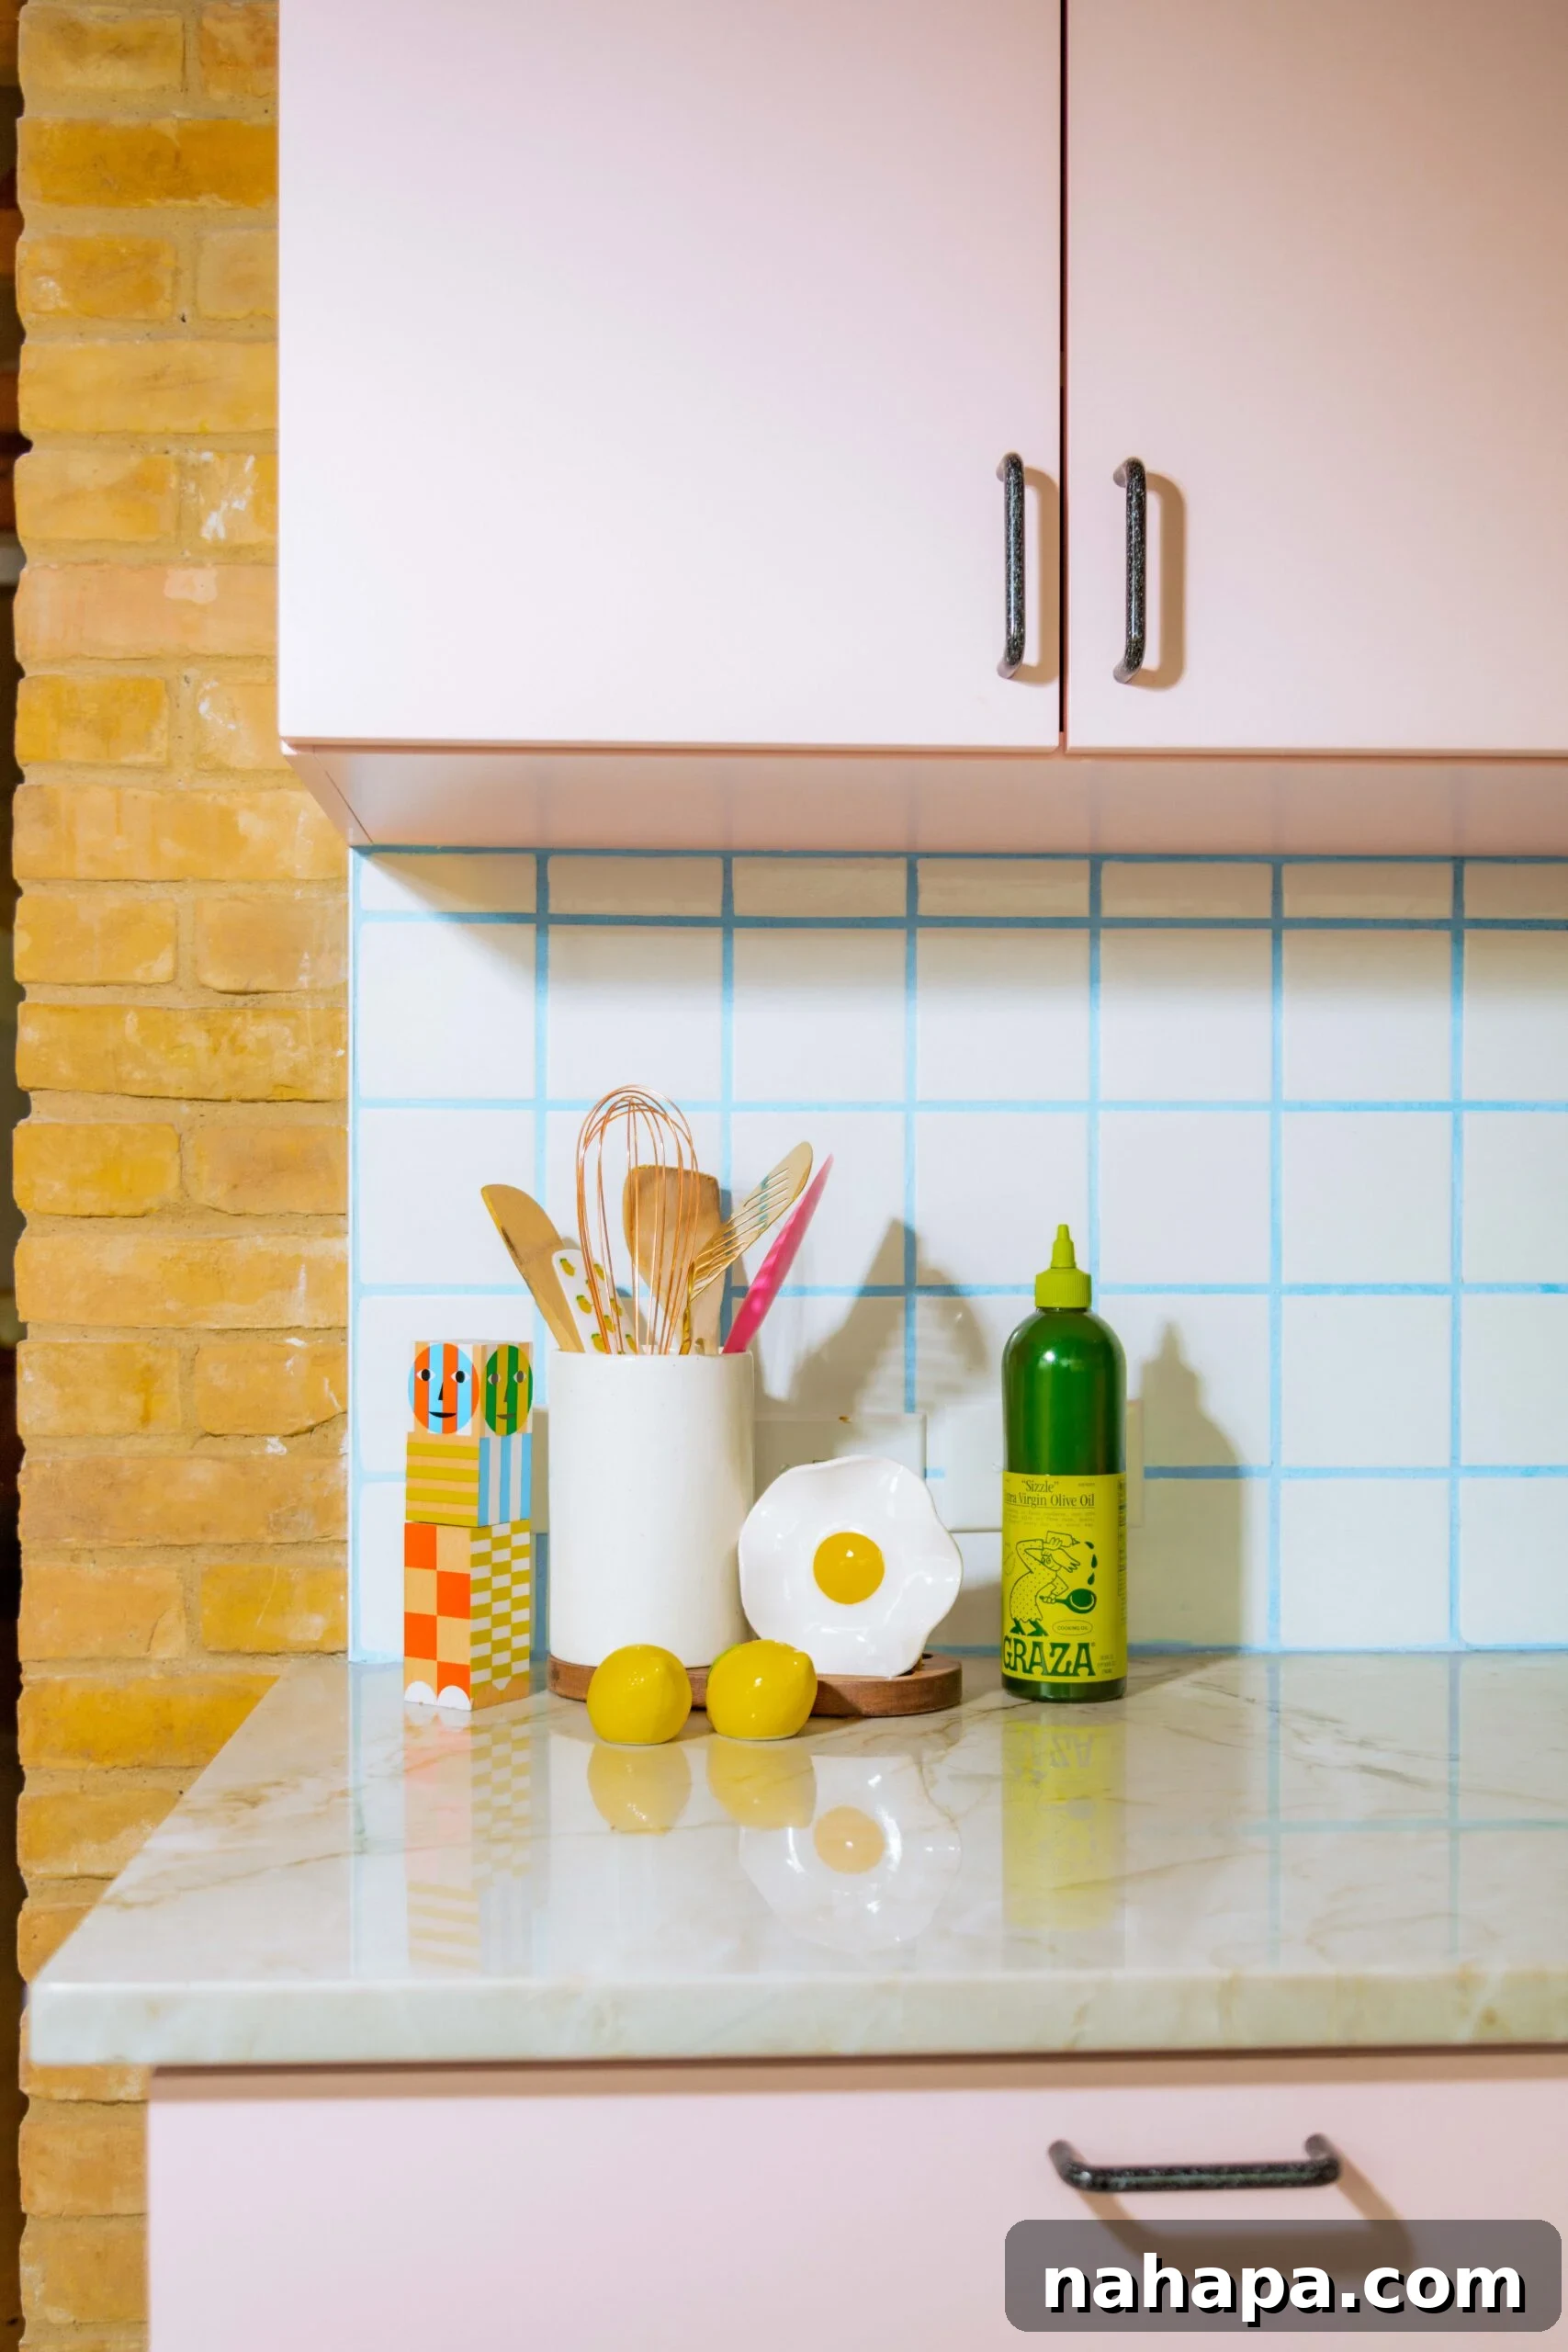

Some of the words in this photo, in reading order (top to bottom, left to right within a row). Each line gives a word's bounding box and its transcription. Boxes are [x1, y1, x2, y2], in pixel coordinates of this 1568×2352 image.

[1018, 1492, 1047, 1509] Virgin
[1050, 1494, 1077, 1507] Olive
[1079, 1493, 1095, 1507] Oil
[1004, 1635, 1097, 1677] GRAZA
